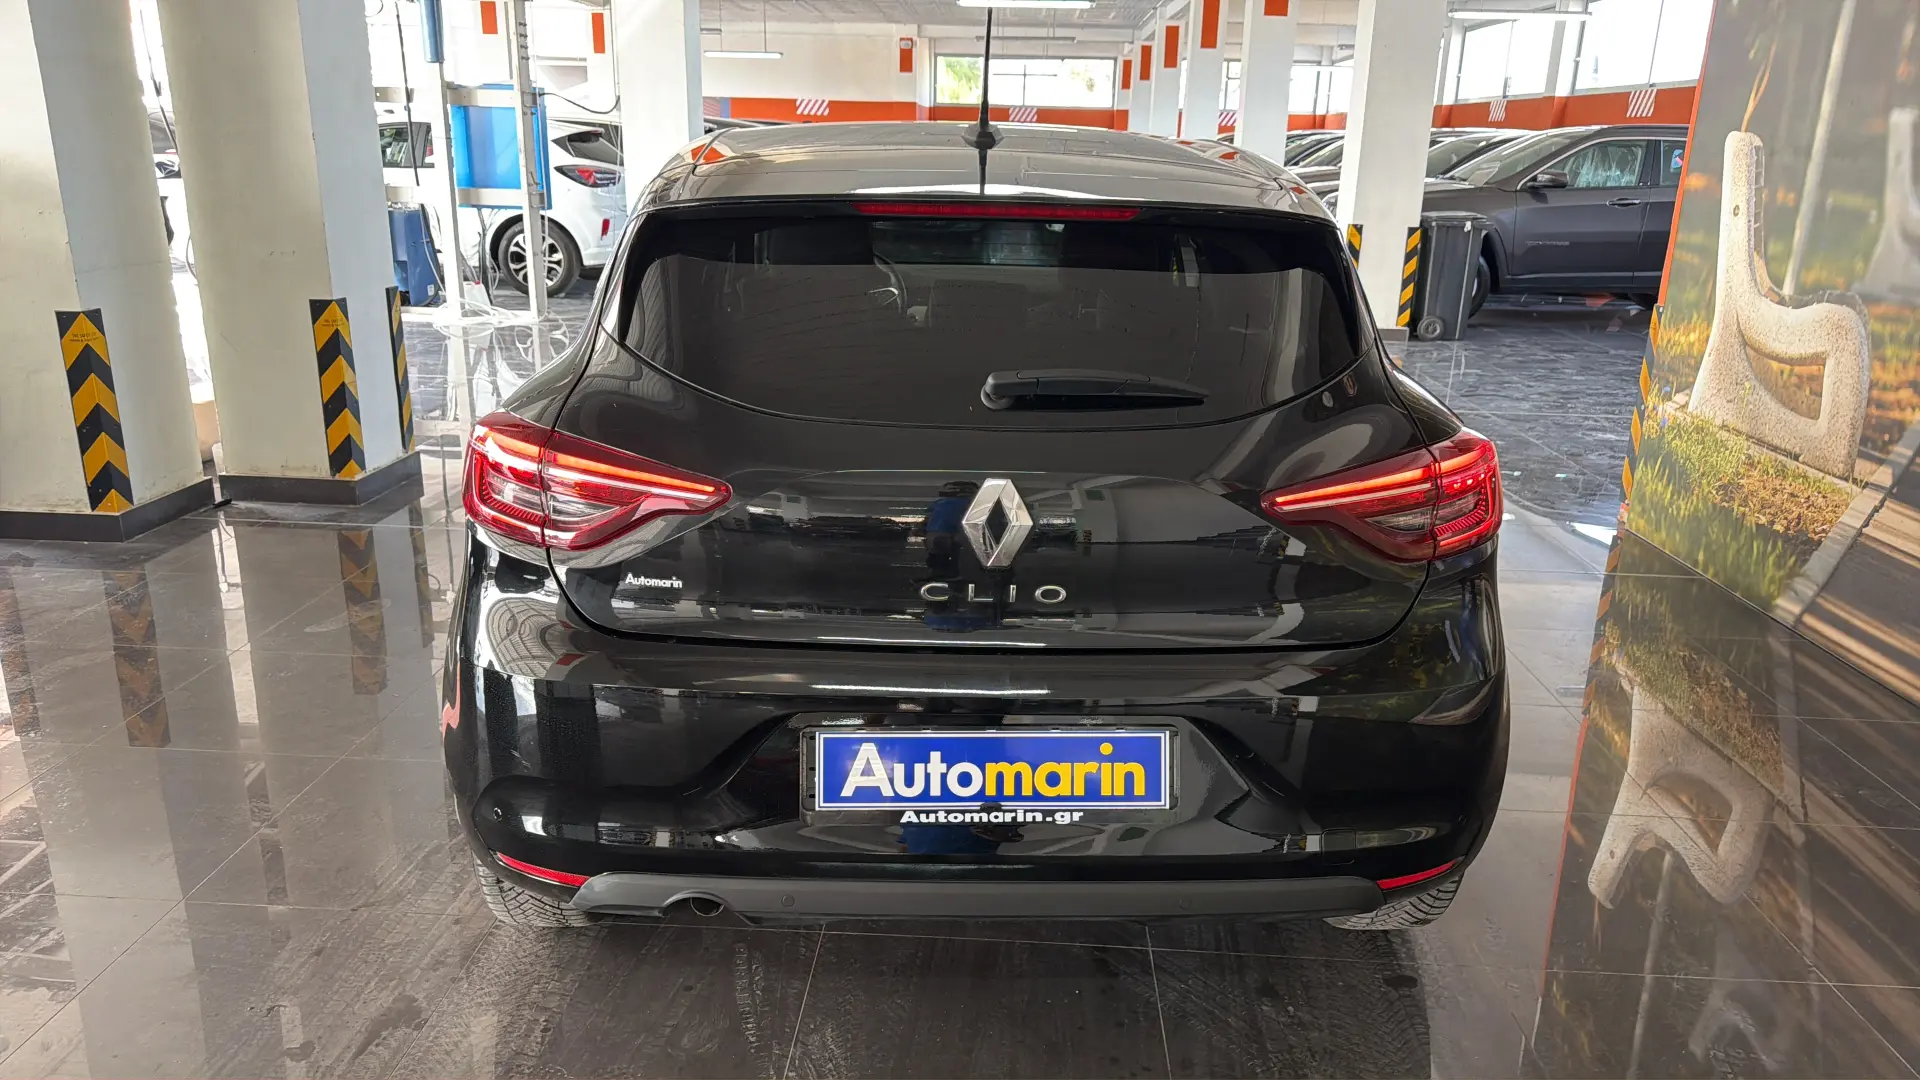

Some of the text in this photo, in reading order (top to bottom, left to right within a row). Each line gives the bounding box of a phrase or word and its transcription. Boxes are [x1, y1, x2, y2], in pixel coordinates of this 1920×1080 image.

[625, 572, 683, 588] Automarin
[920, 582, 1067, 603] CLIO
[840, 742, 1146, 798] Automarin
[900, 810, 1084, 824] Automarin.gr
